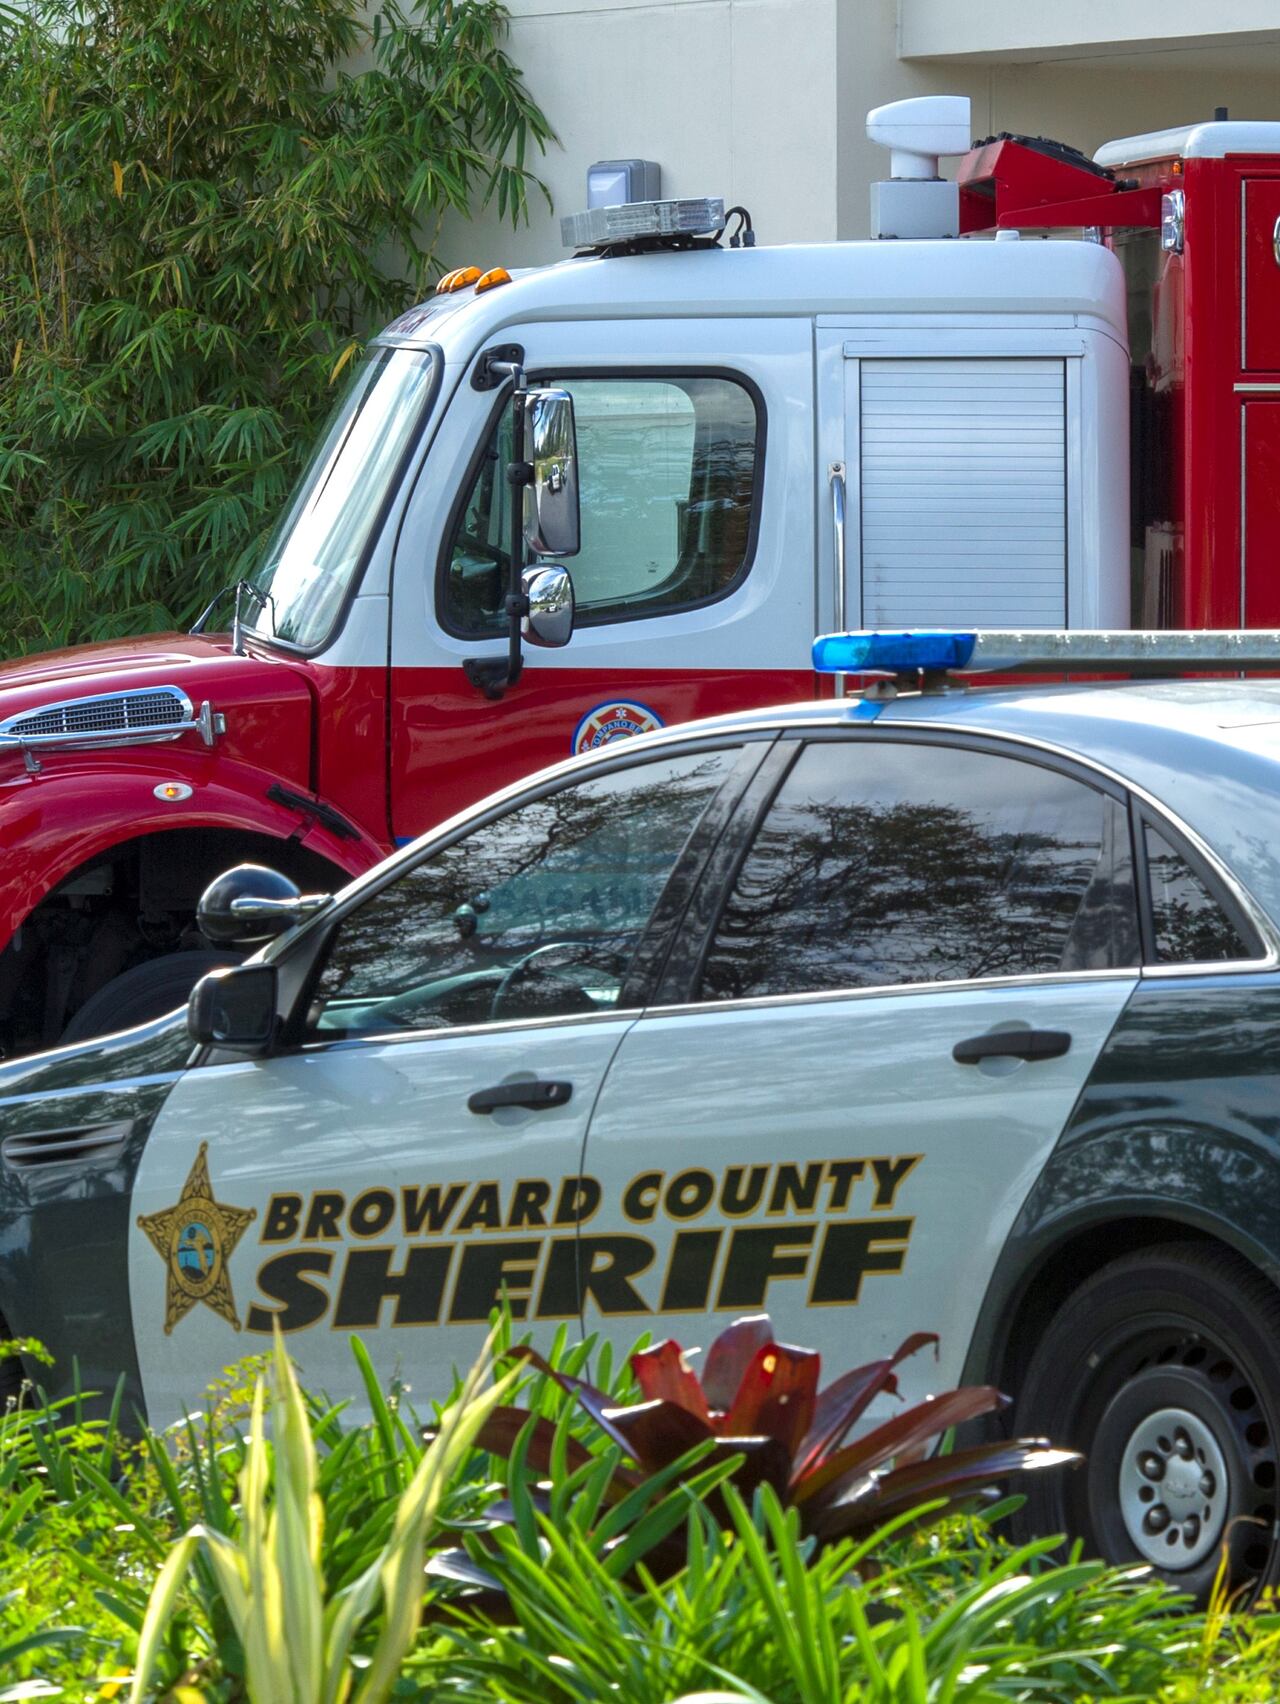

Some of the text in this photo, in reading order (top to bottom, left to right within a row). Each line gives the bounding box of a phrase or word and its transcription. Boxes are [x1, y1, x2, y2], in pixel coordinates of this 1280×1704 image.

[258, 1153, 925, 1246] BROWARD COUNTY
[244, 1216, 916, 1336] SHERIFF
